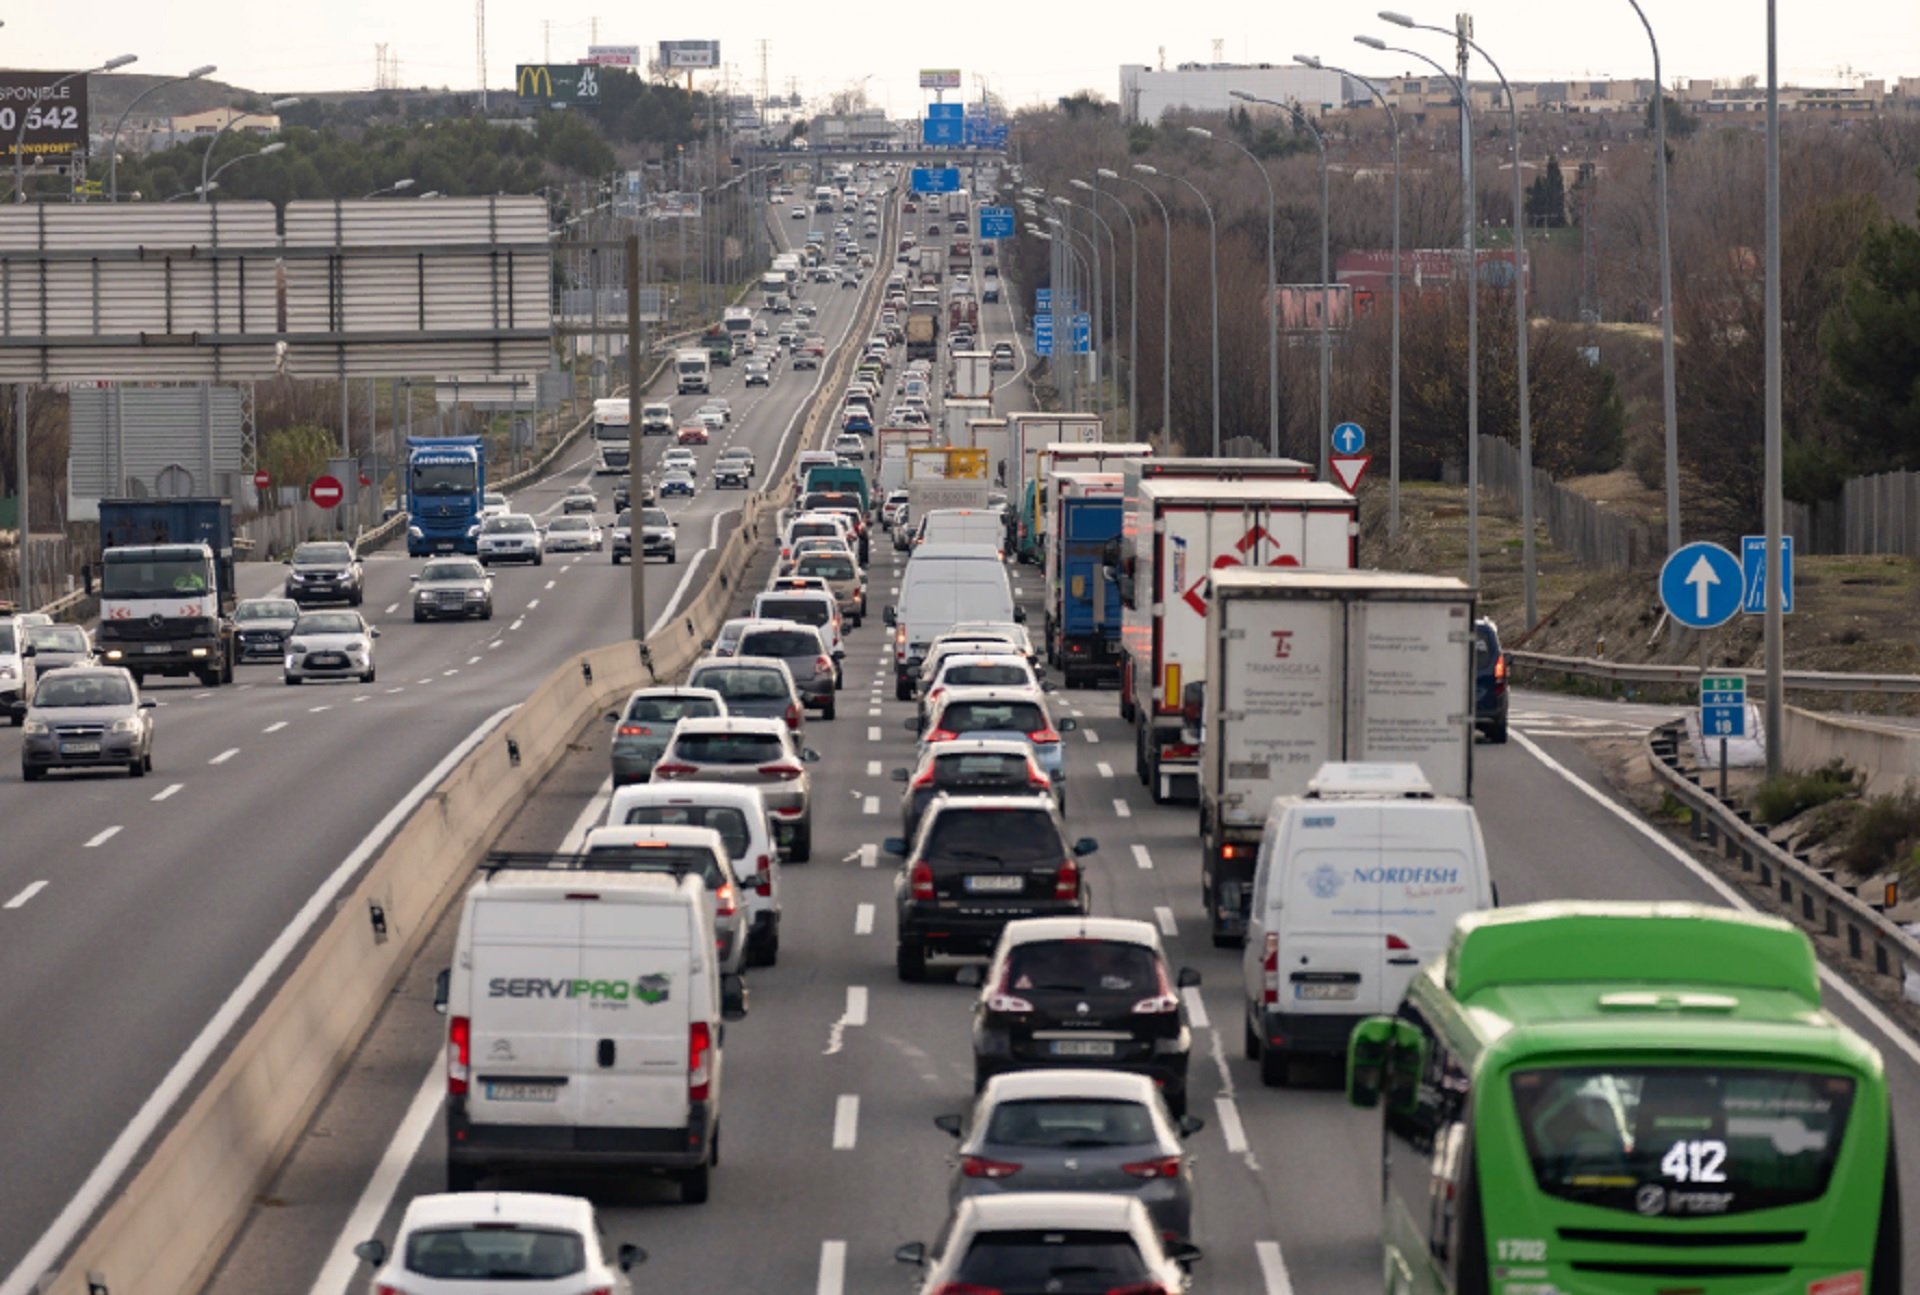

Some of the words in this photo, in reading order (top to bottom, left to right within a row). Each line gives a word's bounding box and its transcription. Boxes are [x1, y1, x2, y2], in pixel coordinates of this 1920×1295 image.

[577, 82, 598, 96] 20
[26, 106, 78, 129] 542
[1245, 663, 1321, 674] TRANSGESA
[1353, 867, 1458, 883] NORDFISH
[489, 978, 629, 1000] SERVIPAQ
[1661, 1140, 1727, 1182] 412
